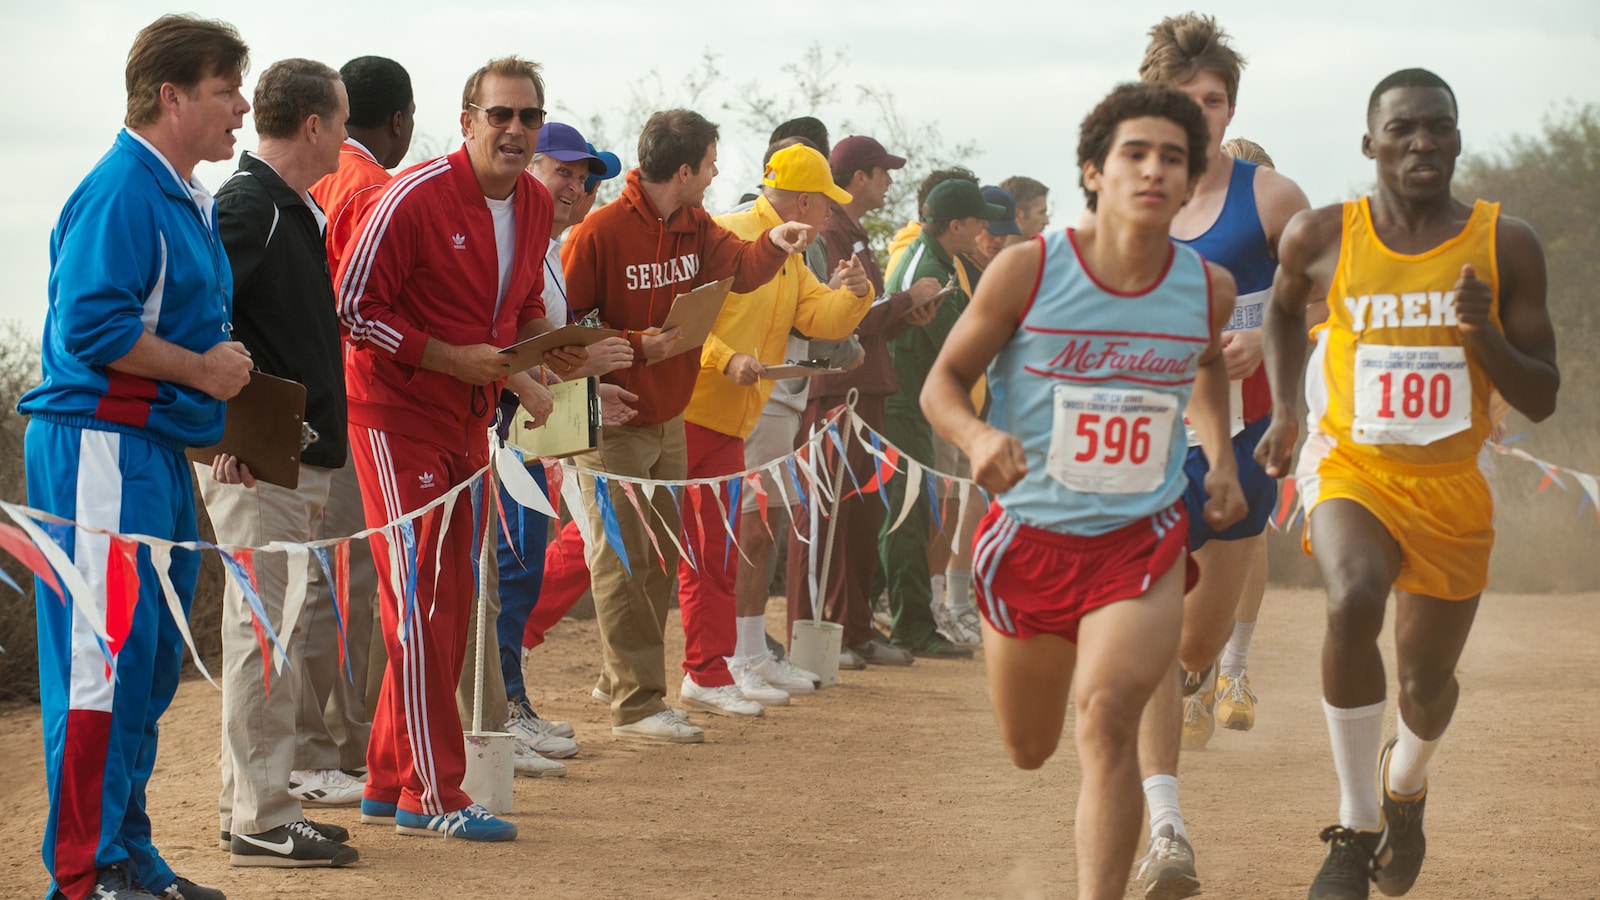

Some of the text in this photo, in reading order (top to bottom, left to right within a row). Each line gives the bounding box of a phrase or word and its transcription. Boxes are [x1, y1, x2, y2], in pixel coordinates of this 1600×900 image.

[1047, 339, 1197, 375] McFarland
[1377, 371, 1452, 419] 180
[1073, 412, 1152, 466] 596
